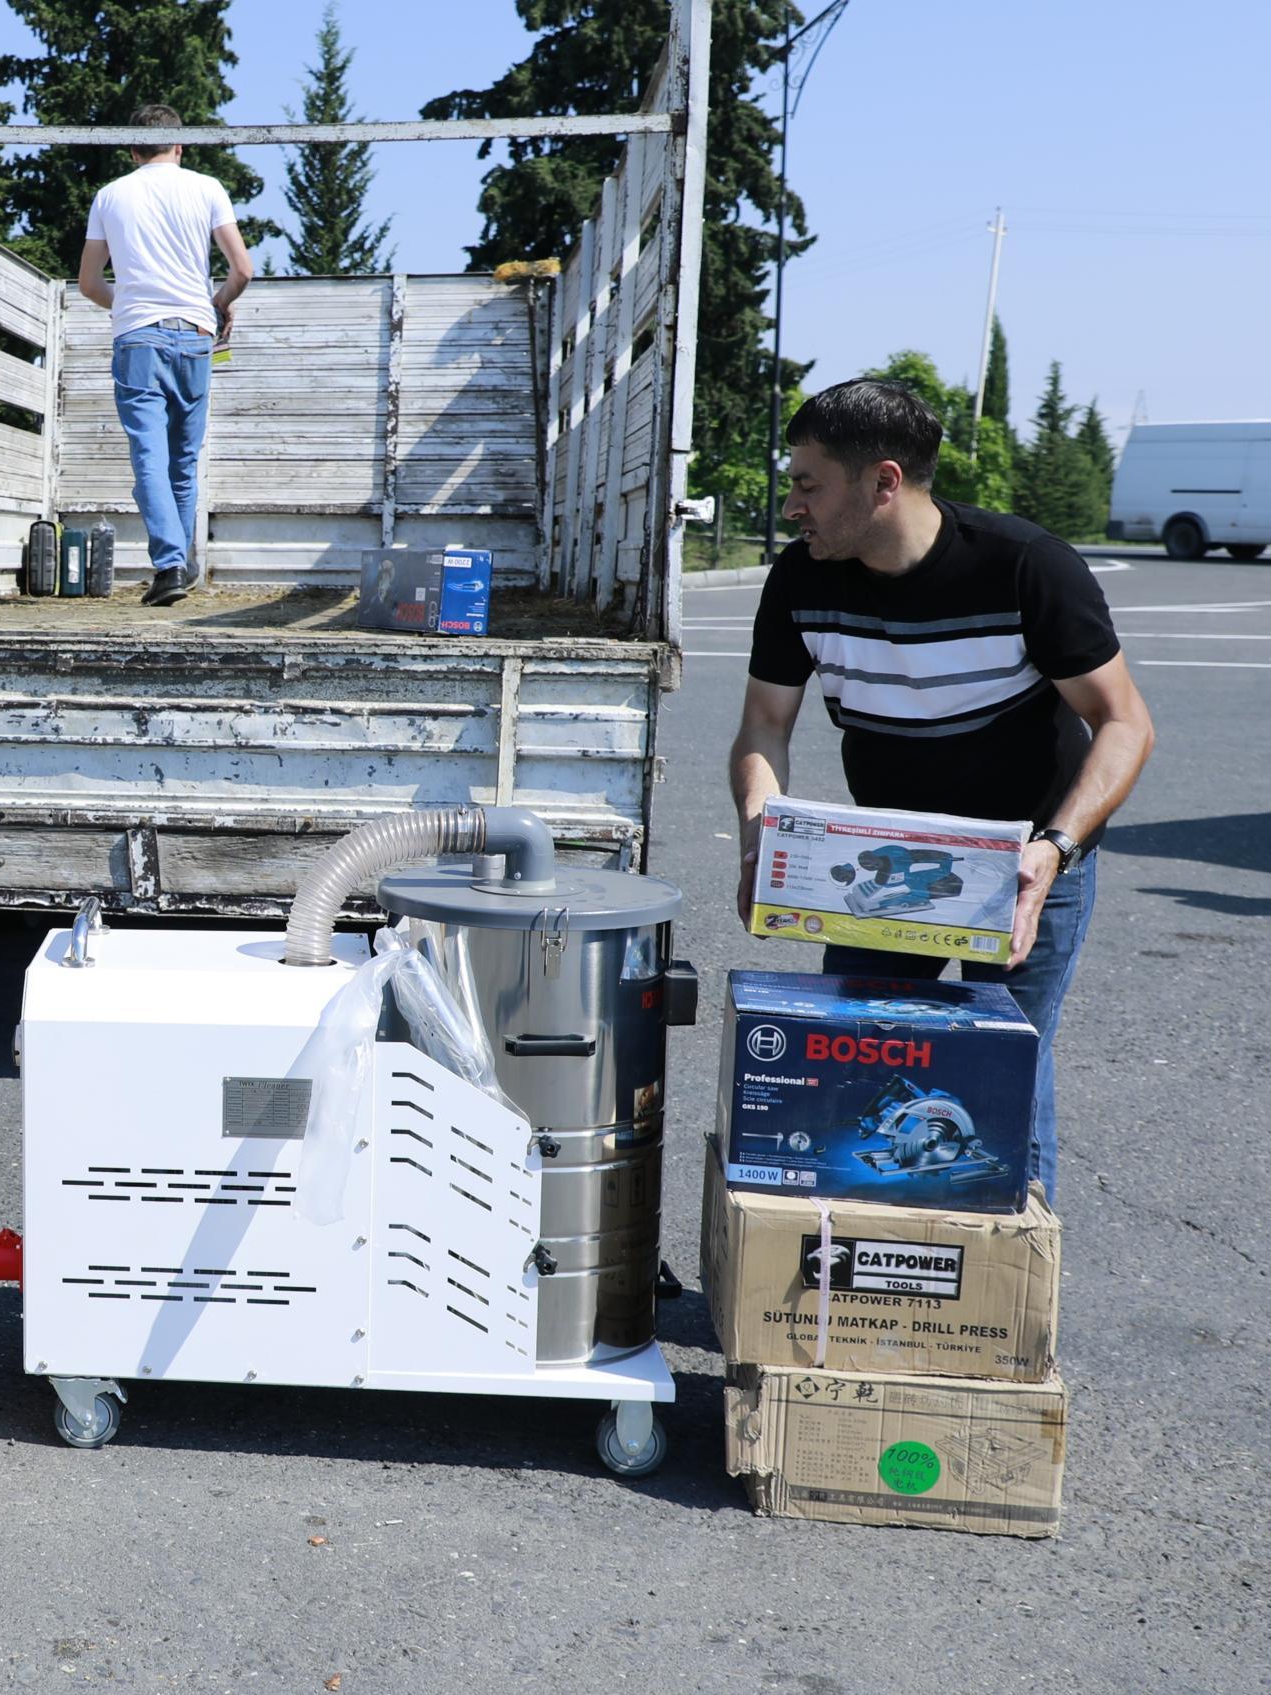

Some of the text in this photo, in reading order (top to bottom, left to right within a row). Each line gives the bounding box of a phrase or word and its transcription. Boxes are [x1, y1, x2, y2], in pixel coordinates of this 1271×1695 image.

[440, 621, 471, 629] BOSCH
[806, 1034, 932, 1068] BOSCH
[744, 1073, 805, 1086] Professional
[927, 1106, 953, 1118] BOSCH
[739, 1168, 779, 1181] 1400 W
[857, 1252, 957, 1274] CATPOWER
[885, 1280, 923, 1291] TOOLS
[830, 1293, 942, 1310] ATPOWER 7113
[837, 1315, 899, 1331] MATKAP
[912, 1320, 955, 1335] DRILL
[959, 1323, 1009, 1340] PRESS
[786, 1332, 819, 1342] GLOBA
[829, 1334, 867, 1345] TEKNİK
[876, 1337, 927, 1349] İSTANBUL
[935, 1342, 982, 1354] TÜRKİYE
[994, 1354, 1030, 1368] 350W
[887, 1447, 937, 1469] 100%
